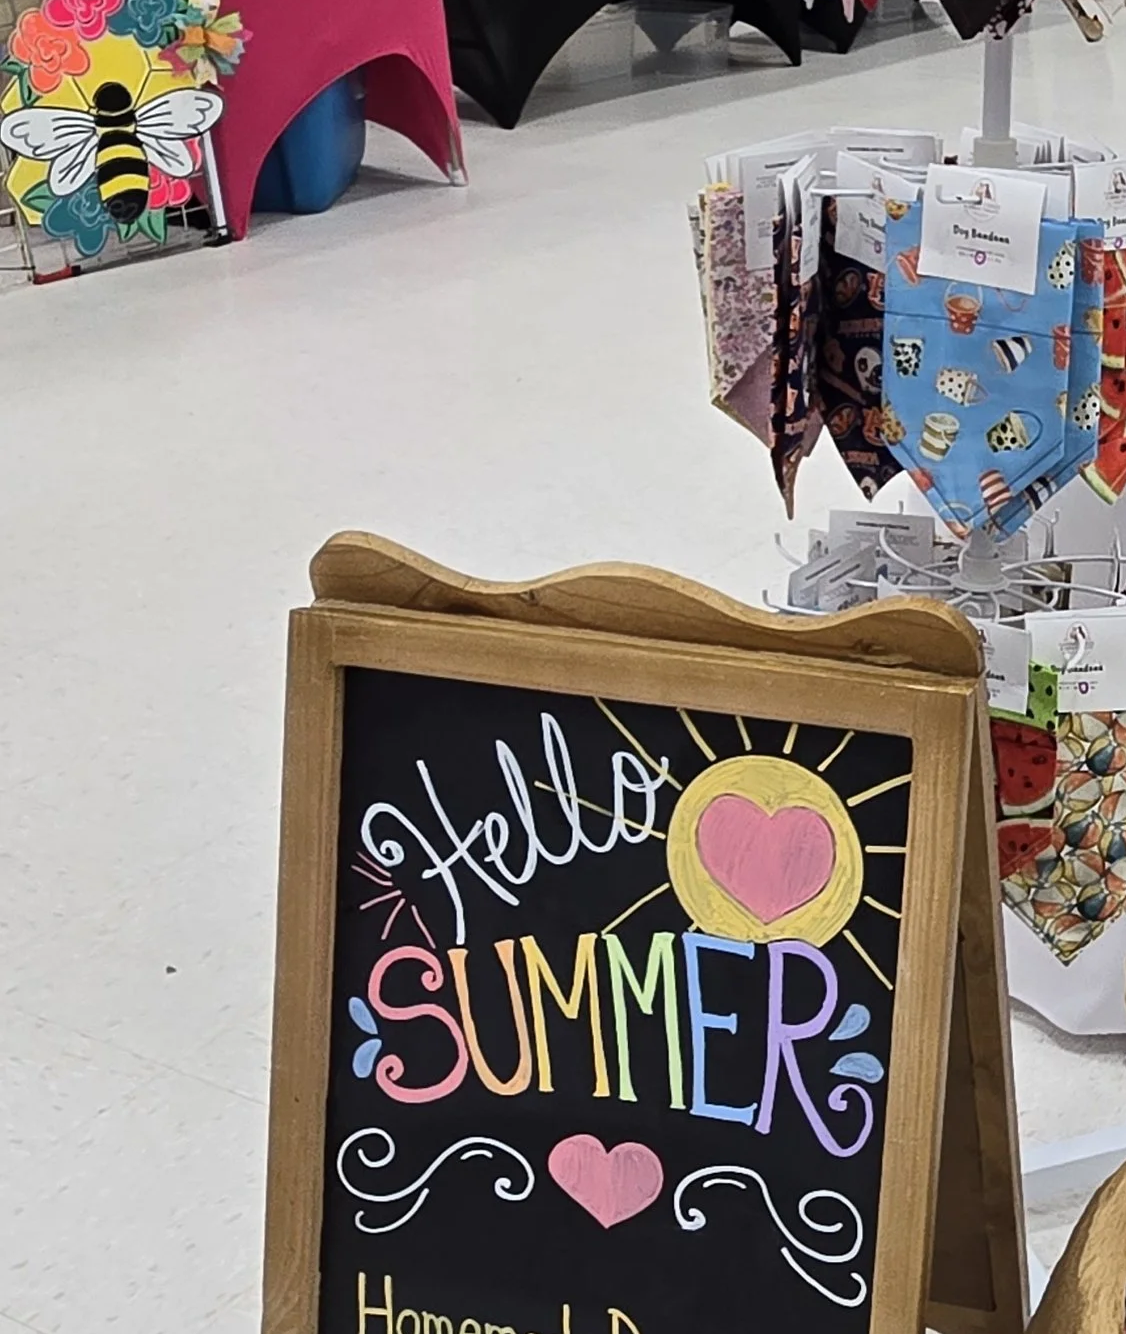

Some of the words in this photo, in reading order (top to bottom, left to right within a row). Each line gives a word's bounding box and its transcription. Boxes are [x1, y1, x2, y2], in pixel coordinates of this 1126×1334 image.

[952, 224, 969, 239] Dog
[970, 227, 1010, 245] Bandana
[361, 712, 670, 945] Hello
[367, 930, 874, 1158] SUMMER
